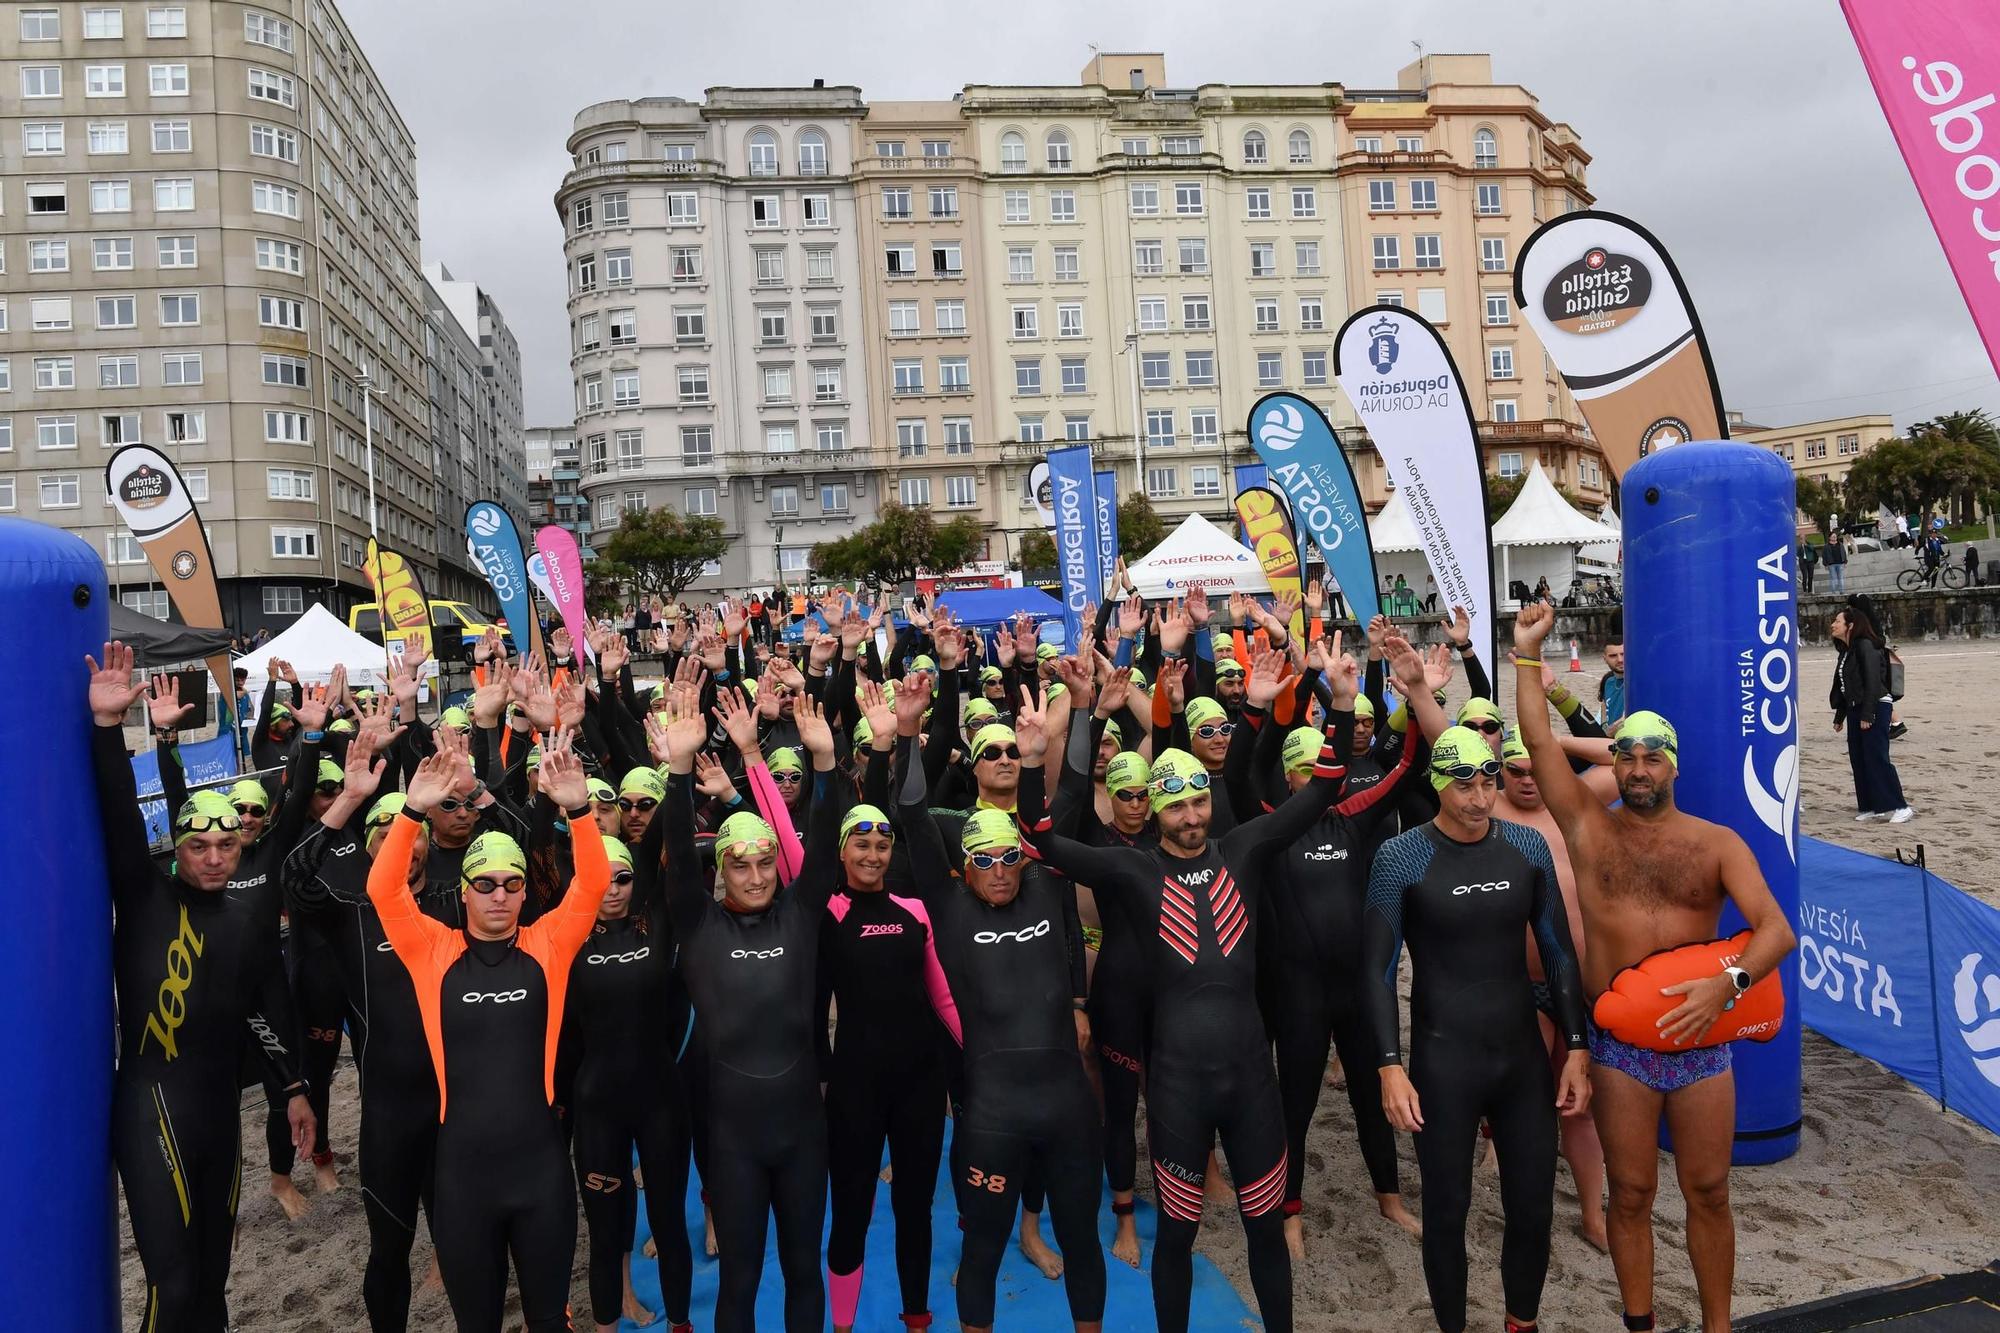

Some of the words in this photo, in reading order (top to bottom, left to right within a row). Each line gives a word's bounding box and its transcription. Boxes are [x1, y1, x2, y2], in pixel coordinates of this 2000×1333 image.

[1757, 544, 1792, 735] COSTA
[1743, 649, 1754, 737] TRAVESÍA
[192, 758, 224, 776] TRAVESÍA
[1350, 774, 1380, 783] orca
[1304, 848, 1348, 861] nabaiji
[226, 873, 268, 890] OGGS
[1452, 880, 1510, 896] orca
[859, 923, 904, 938] ZOGGS
[973, 919, 1050, 944] orca
[587, 946, 650, 965] orca
[730, 946, 784, 960] orca
[1800, 935, 1903, 1028] OSTA
[462, 988, 528, 1003] orca
